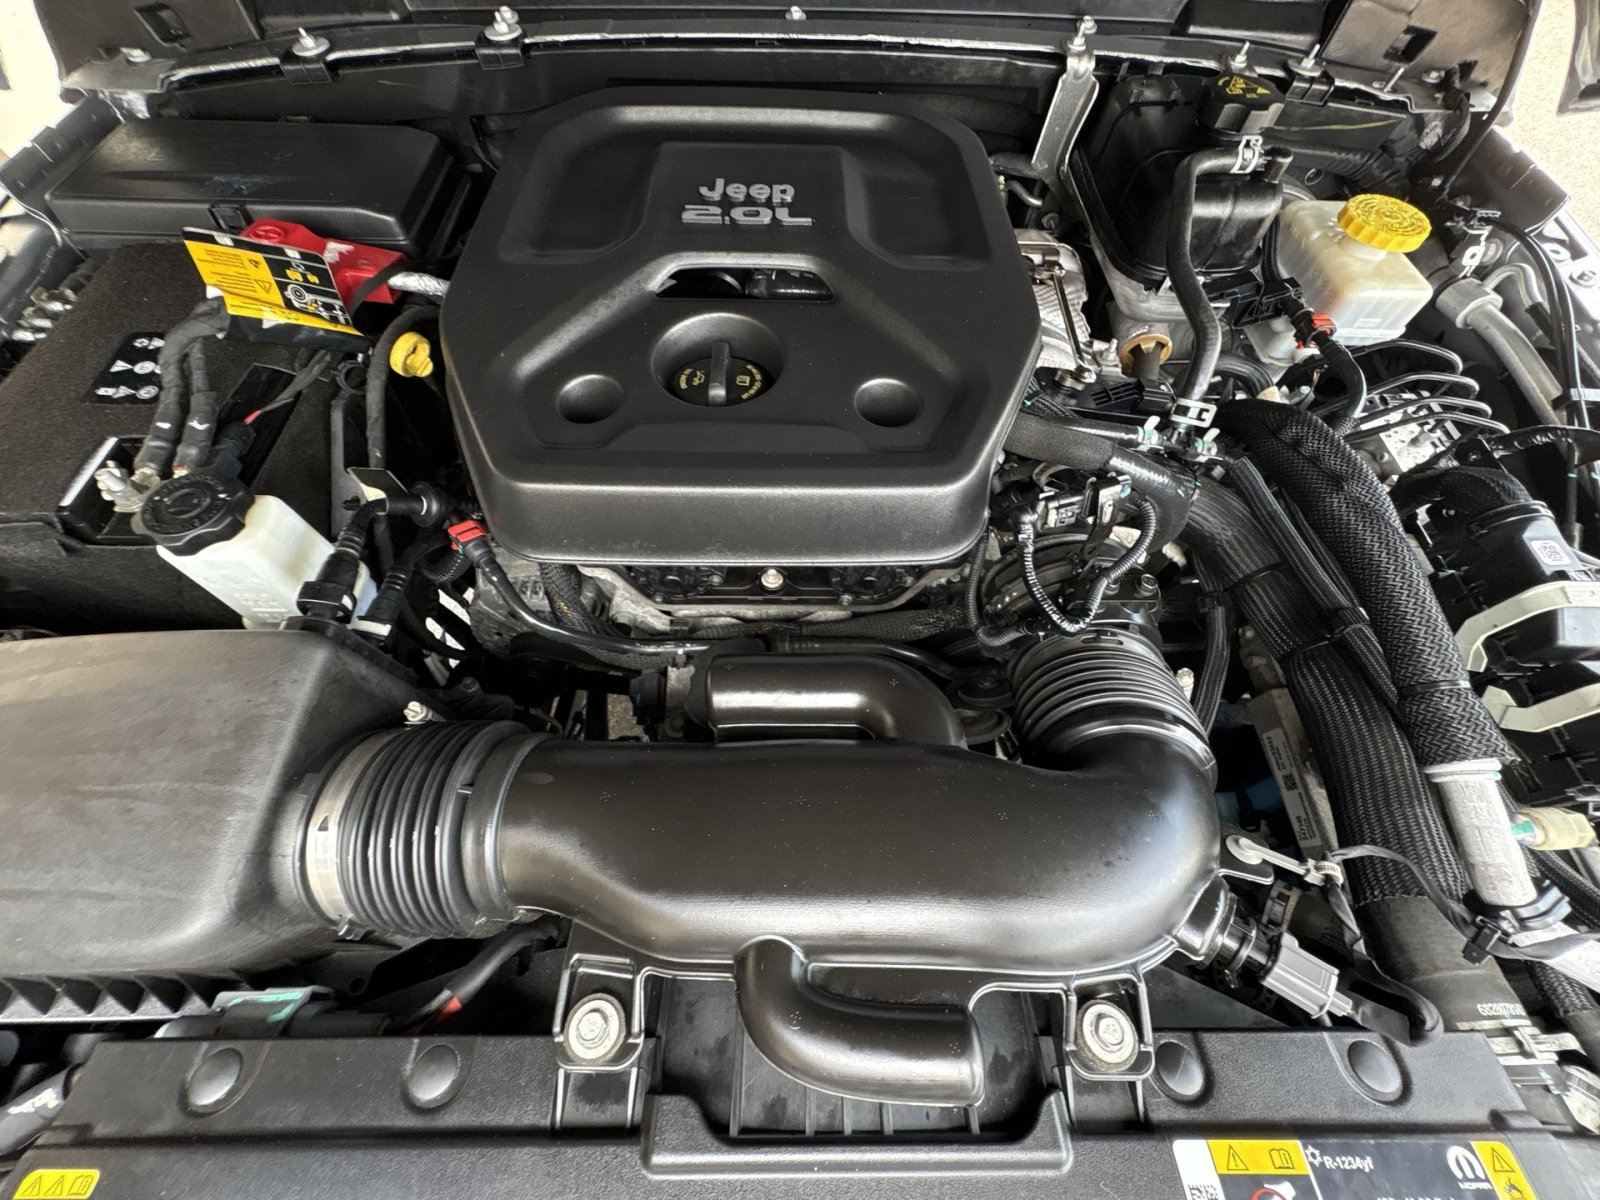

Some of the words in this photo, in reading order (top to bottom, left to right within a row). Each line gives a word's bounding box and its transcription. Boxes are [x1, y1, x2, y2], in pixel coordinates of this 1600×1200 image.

[699, 178, 795, 206] Jeep
[681, 204, 813, 226] 2.0L
[1322, 1154, 1374, 1173] R-1234yf
